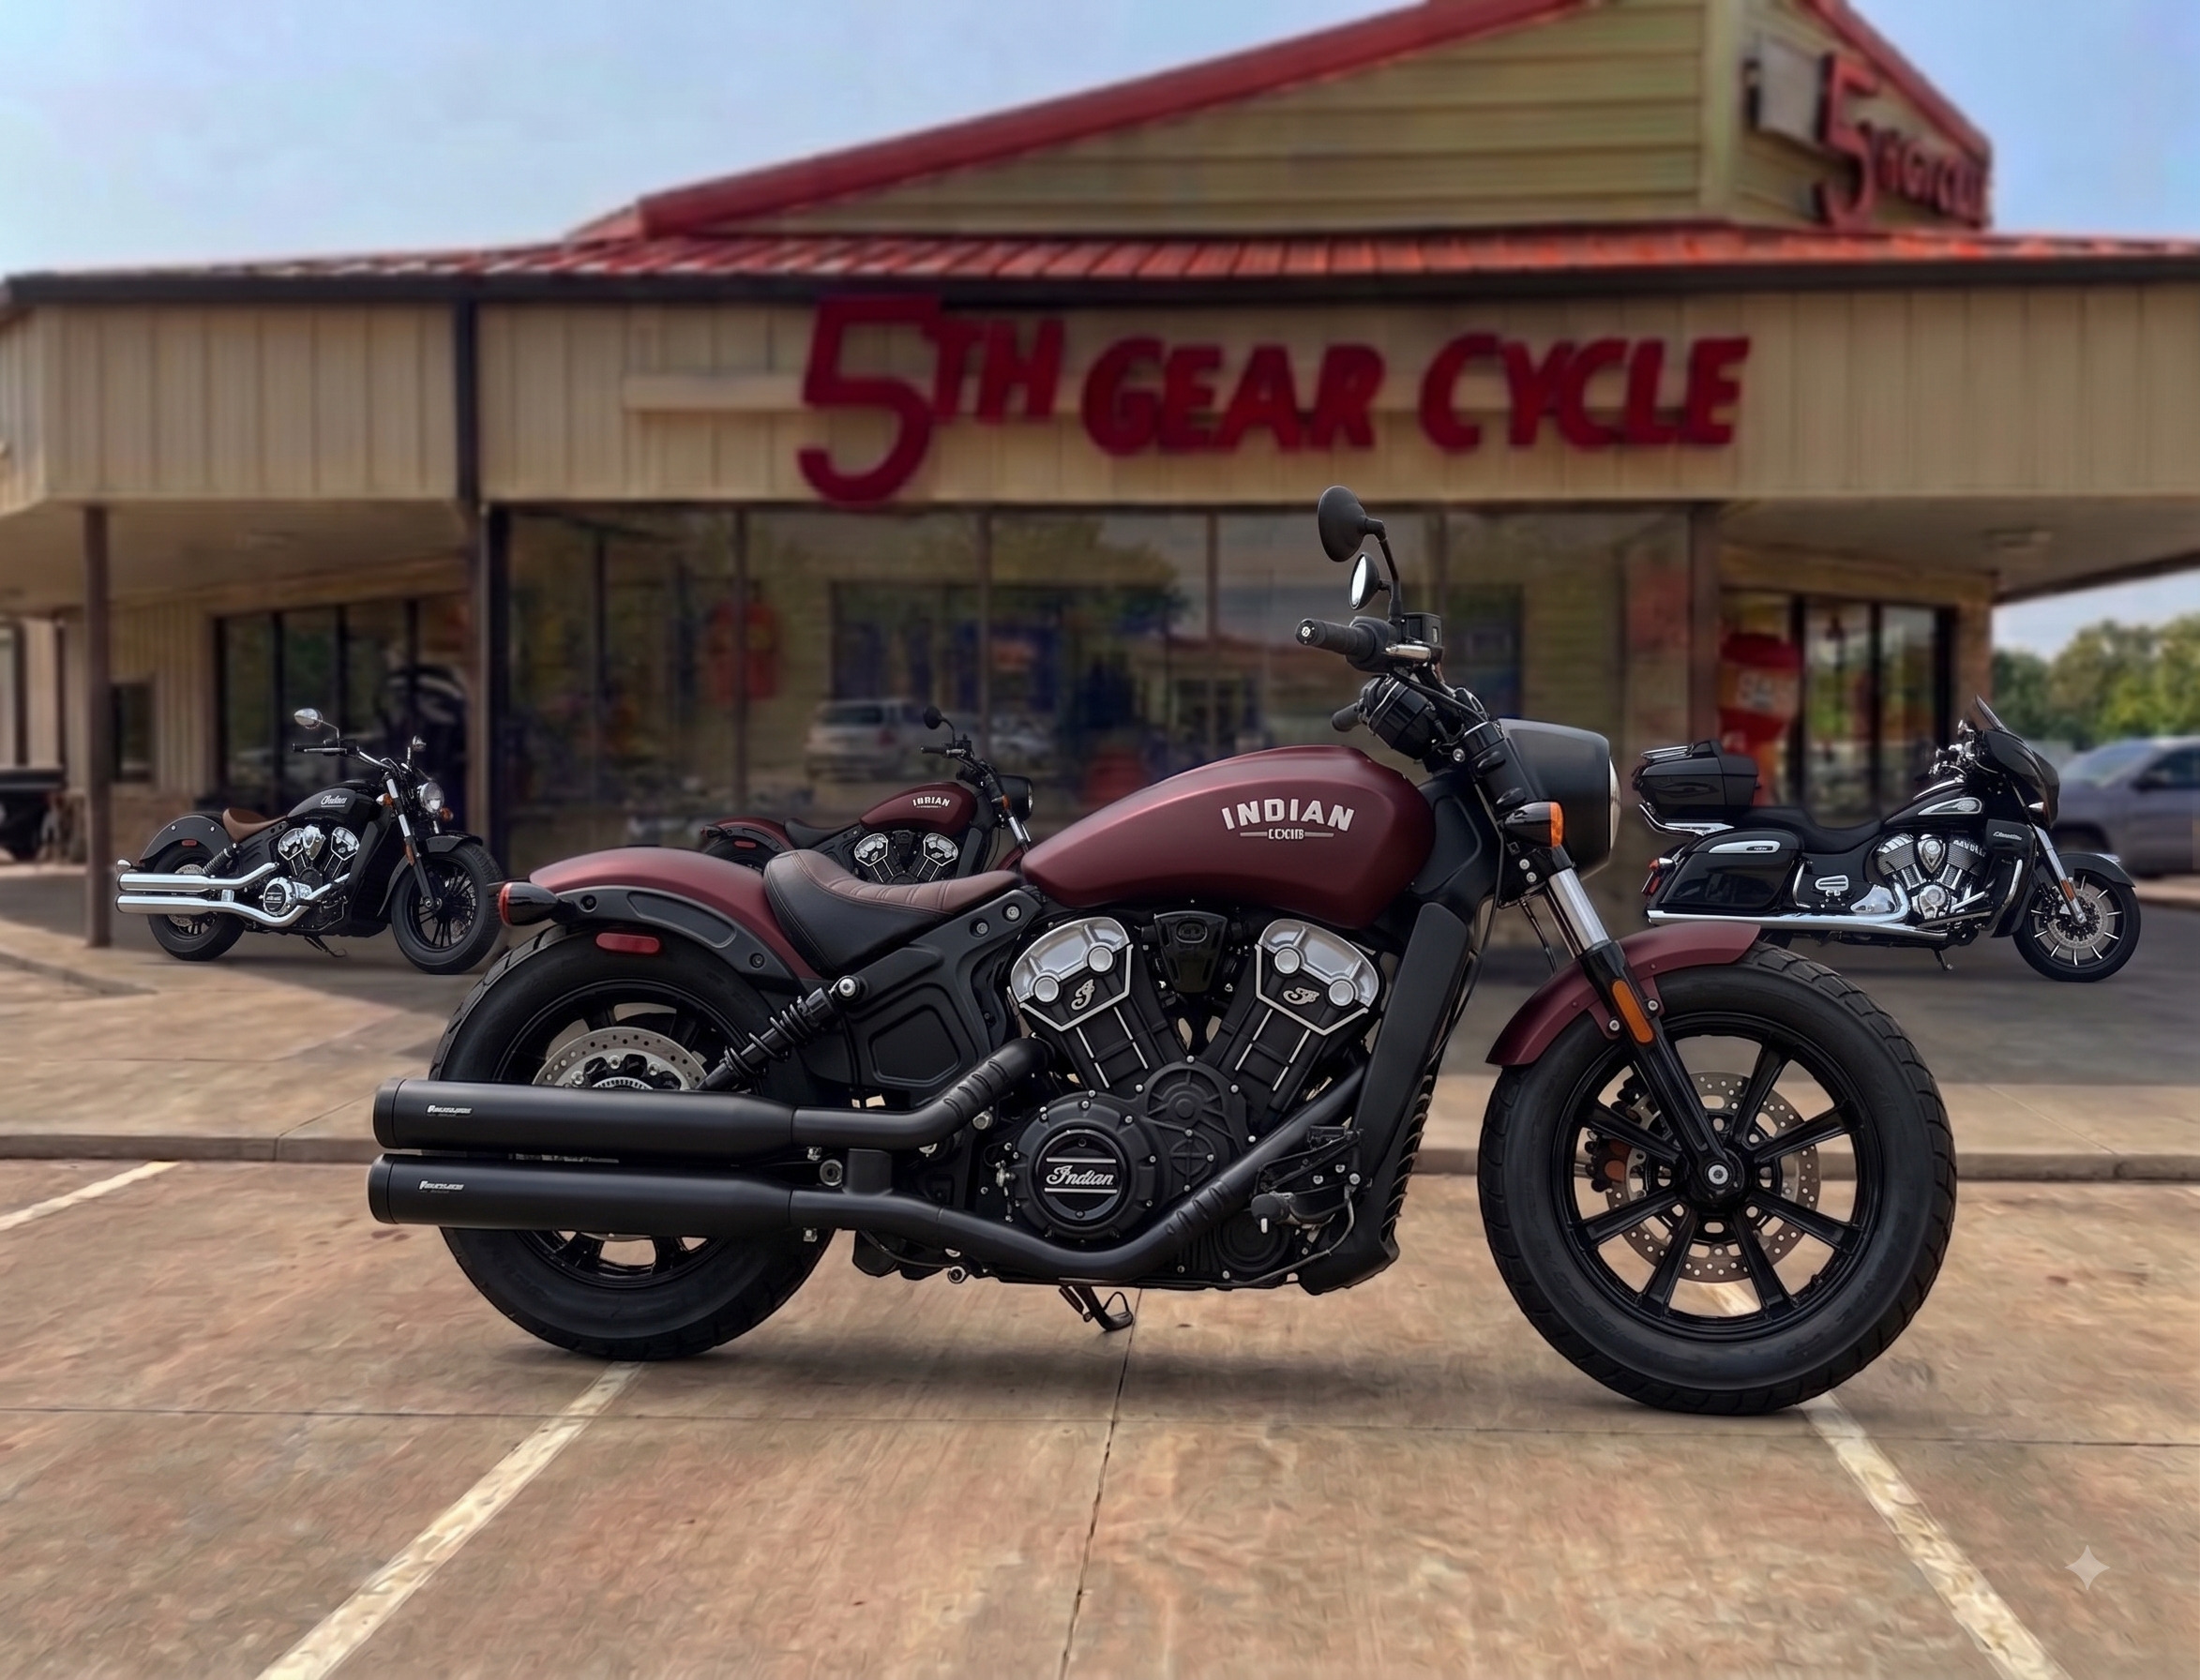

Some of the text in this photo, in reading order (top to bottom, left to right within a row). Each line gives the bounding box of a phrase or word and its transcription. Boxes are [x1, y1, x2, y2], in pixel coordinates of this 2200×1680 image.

[798, 296, 1749, 508] 5TH GEAR CYCLE
[1221, 798, 1355, 832] INDIAN
[1046, 1164, 1114, 1186] Indian
